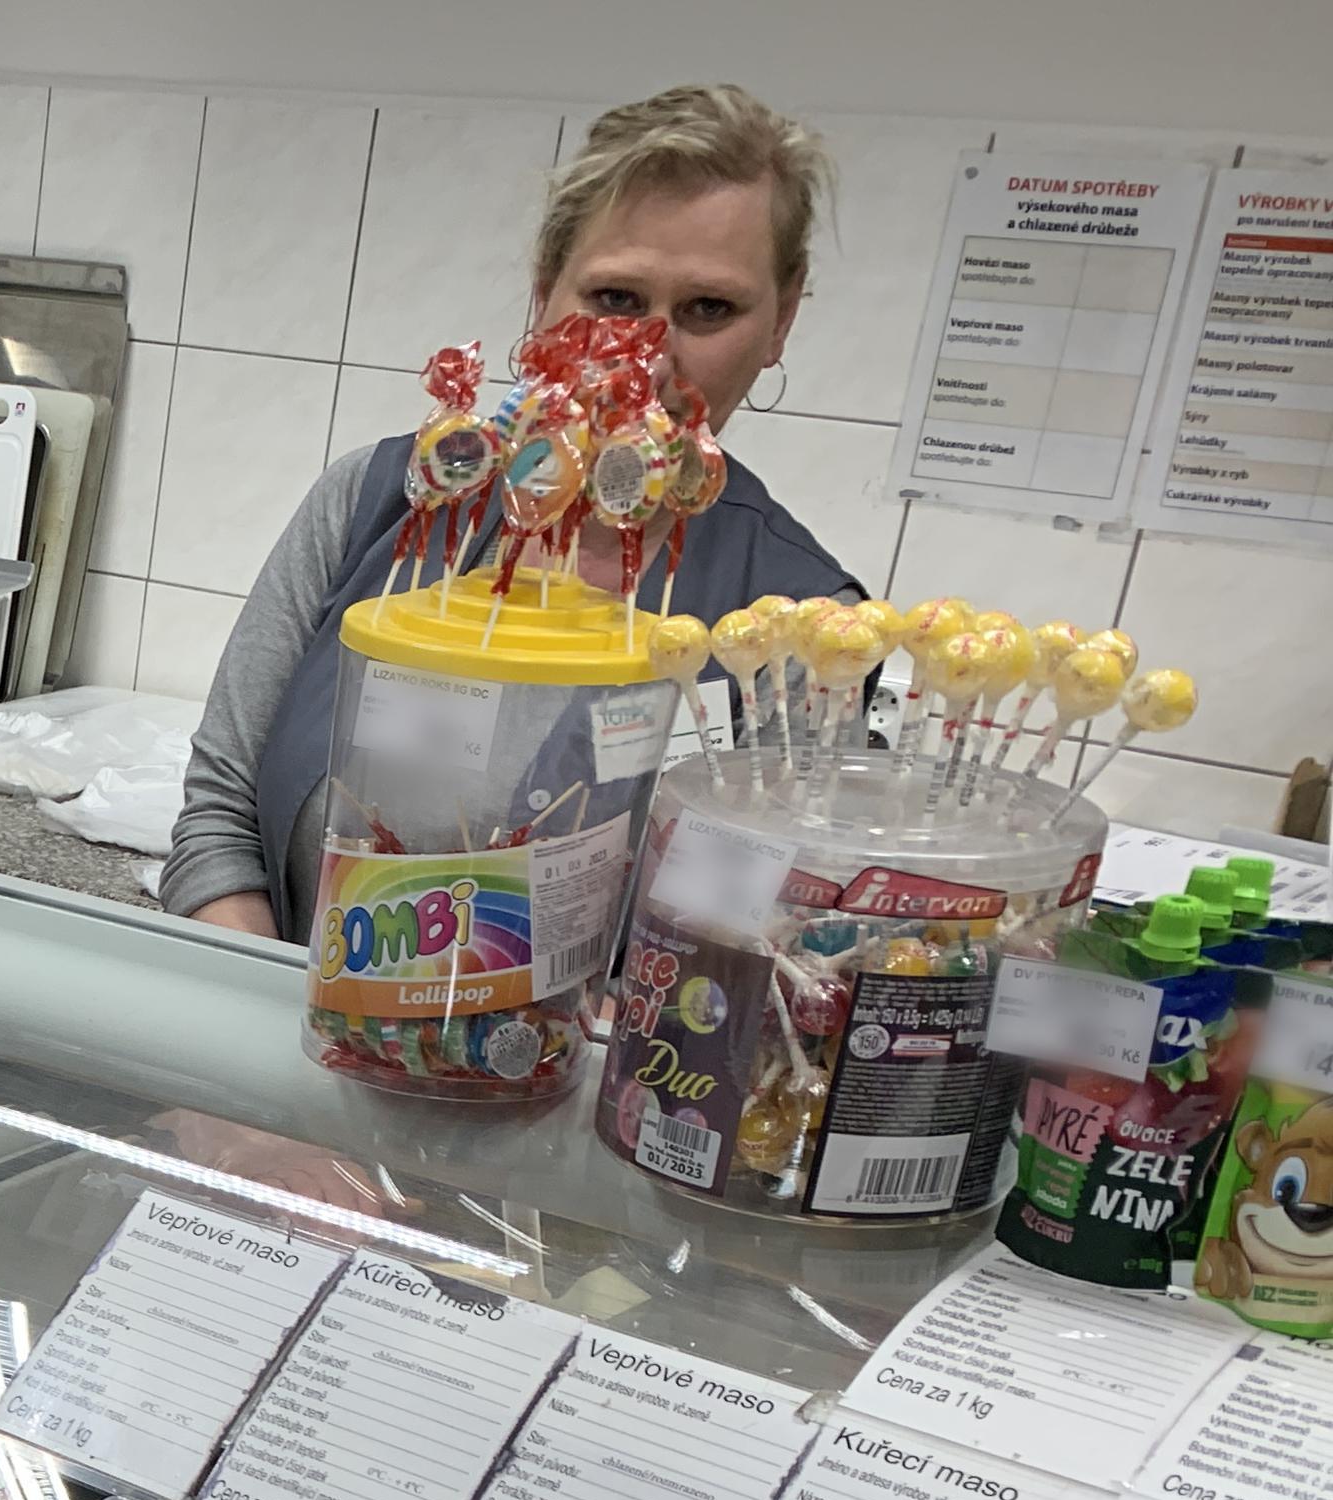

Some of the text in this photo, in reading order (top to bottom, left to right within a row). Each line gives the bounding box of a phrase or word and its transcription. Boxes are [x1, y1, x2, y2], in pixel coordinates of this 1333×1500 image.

[1007, 177, 1159, 198] DATUM SPOTŘEBY
[1017, 199, 1138, 217] výsekového masa
[1239, 193, 1319, 212] VÝROBKY
[1018, 218, 1139, 237] chlazené drůbeže
[1238, 215, 1309, 229] po narušení
[964, 256, 1030, 270] Hovězí maso
[1224, 252, 1312, 267] Masný výrobek
[1221, 265, 1263, 278] tepelně
[1254, 293, 1301, 308] výrobek
[1211, 305, 1292, 320] neopracovaný
[950, 317, 1024, 333] Vepřové maso
[1204, 330, 1291, 348] Masný výrobek
[1197, 357, 1294, 373] Masný polotovar
[937, 377, 988, 391] Vnitřnosti
[1237, 387, 1277, 402] salámy
[1185, 410, 1210, 424] Sýry
[923, 437, 976, 452] Chlazenou
[373, 668, 451, 690] LIZATKO ROKS
[398, 984, 494, 1006] Lollipop
[858, 1034, 879, 1050] 150
[1121, 1047, 1141, 1064] Kč
[635, 1038, 719, 1101] Duo
[1037, 1096, 1099, 1155] PYRÉ
[1120, 1120, 1177, 1145] OVOCE
[1107, 1146, 1195, 1187] ZELE
[148, 1202, 300, 1269] Vepřové maso
[589, 1338, 776, 1416] Vepřové maso
[876, 1366, 994, 1418] Cena za kg
[833, 1427, 934, 1475] Kuřecí
[859, 1470, 893, 1491] adresa
